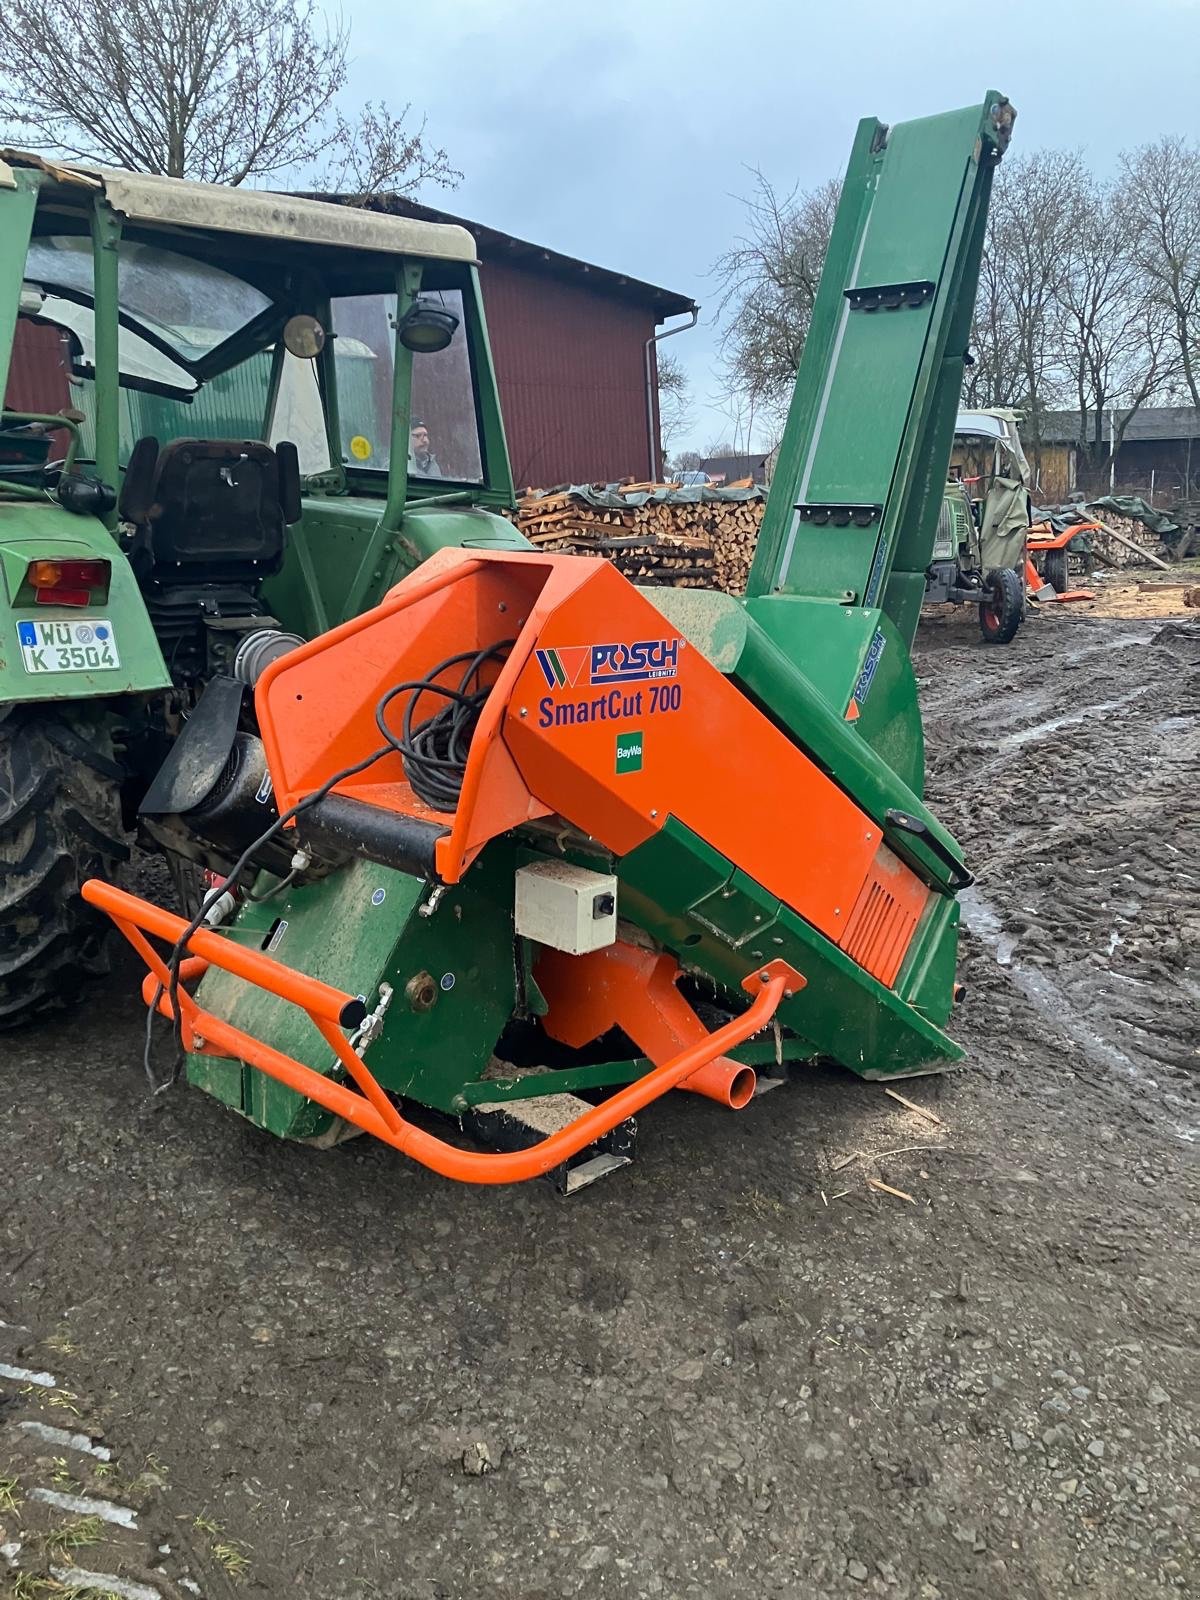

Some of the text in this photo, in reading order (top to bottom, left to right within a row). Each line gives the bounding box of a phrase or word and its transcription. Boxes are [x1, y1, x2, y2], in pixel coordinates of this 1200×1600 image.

[26, 636, 32, 645] D
[40, 623, 73, 646] WÜ
[31, 646, 115, 670] K 3504
[591, 639, 679, 674] POSCH
[538, 684, 682, 728] SmartCut 700
[617, 745, 642, 759] BayWa
